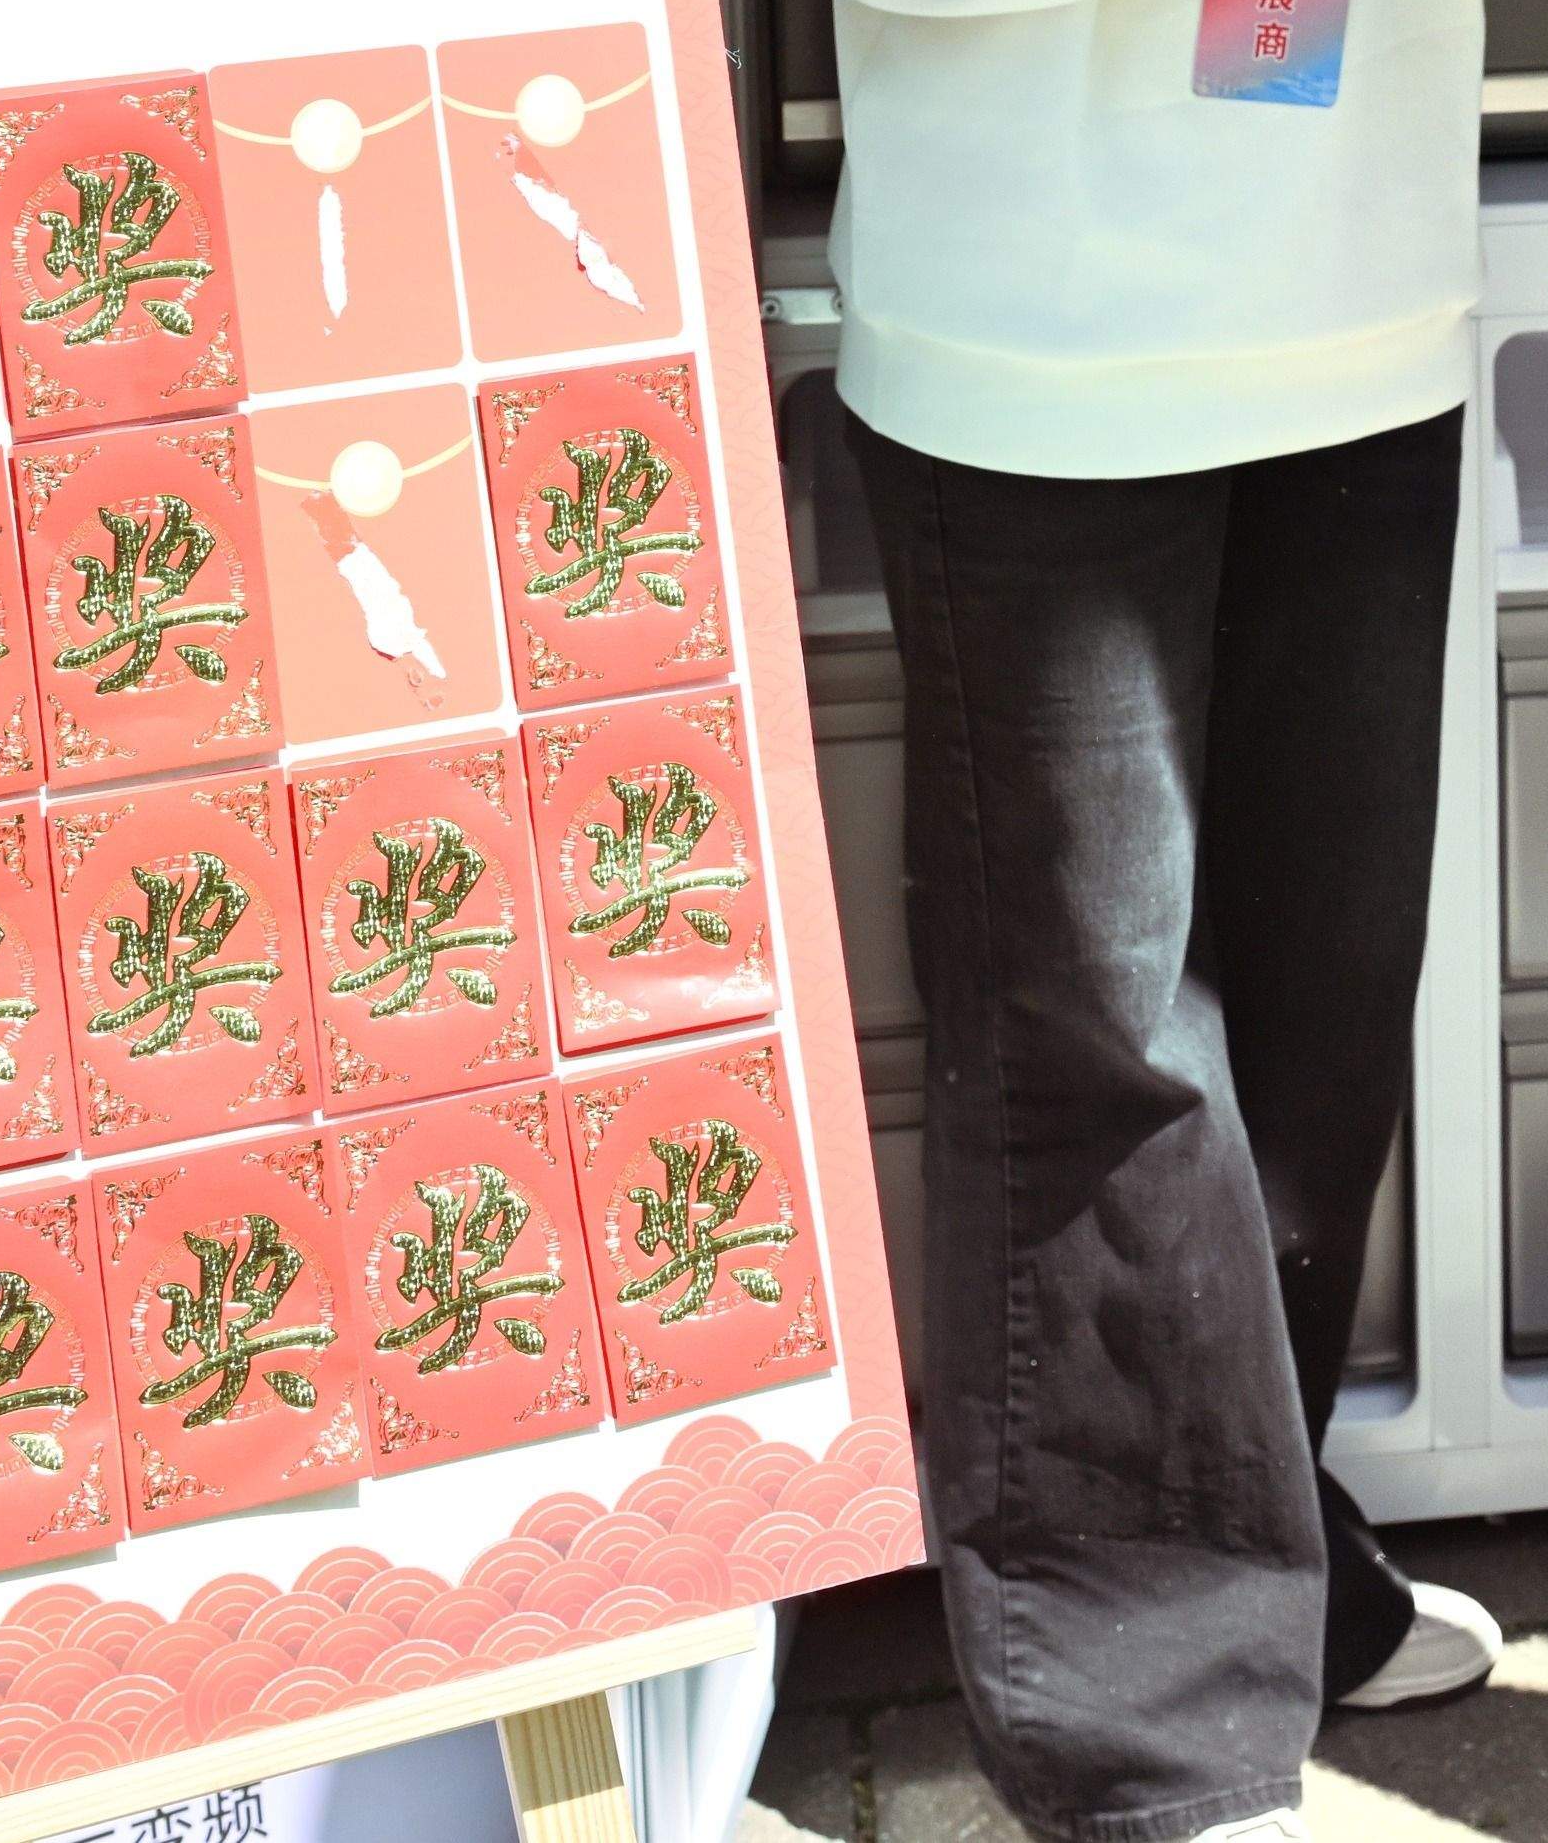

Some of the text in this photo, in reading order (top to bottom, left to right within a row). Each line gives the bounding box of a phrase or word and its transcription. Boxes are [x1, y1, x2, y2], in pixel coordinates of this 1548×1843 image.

[30, 155, 206, 343] 奖
[61, 502, 242, 692] 奖
[533, 439, 698, 615] 奖
[88, 852, 280, 1055] 奖
[327, 818, 498, 1015] 奖
[572, 764, 750, 958] 奖
[376, 1166, 564, 1374] 奖
[626, 1121, 796, 1324] 奖
[142, 1216, 334, 1431] 奖
